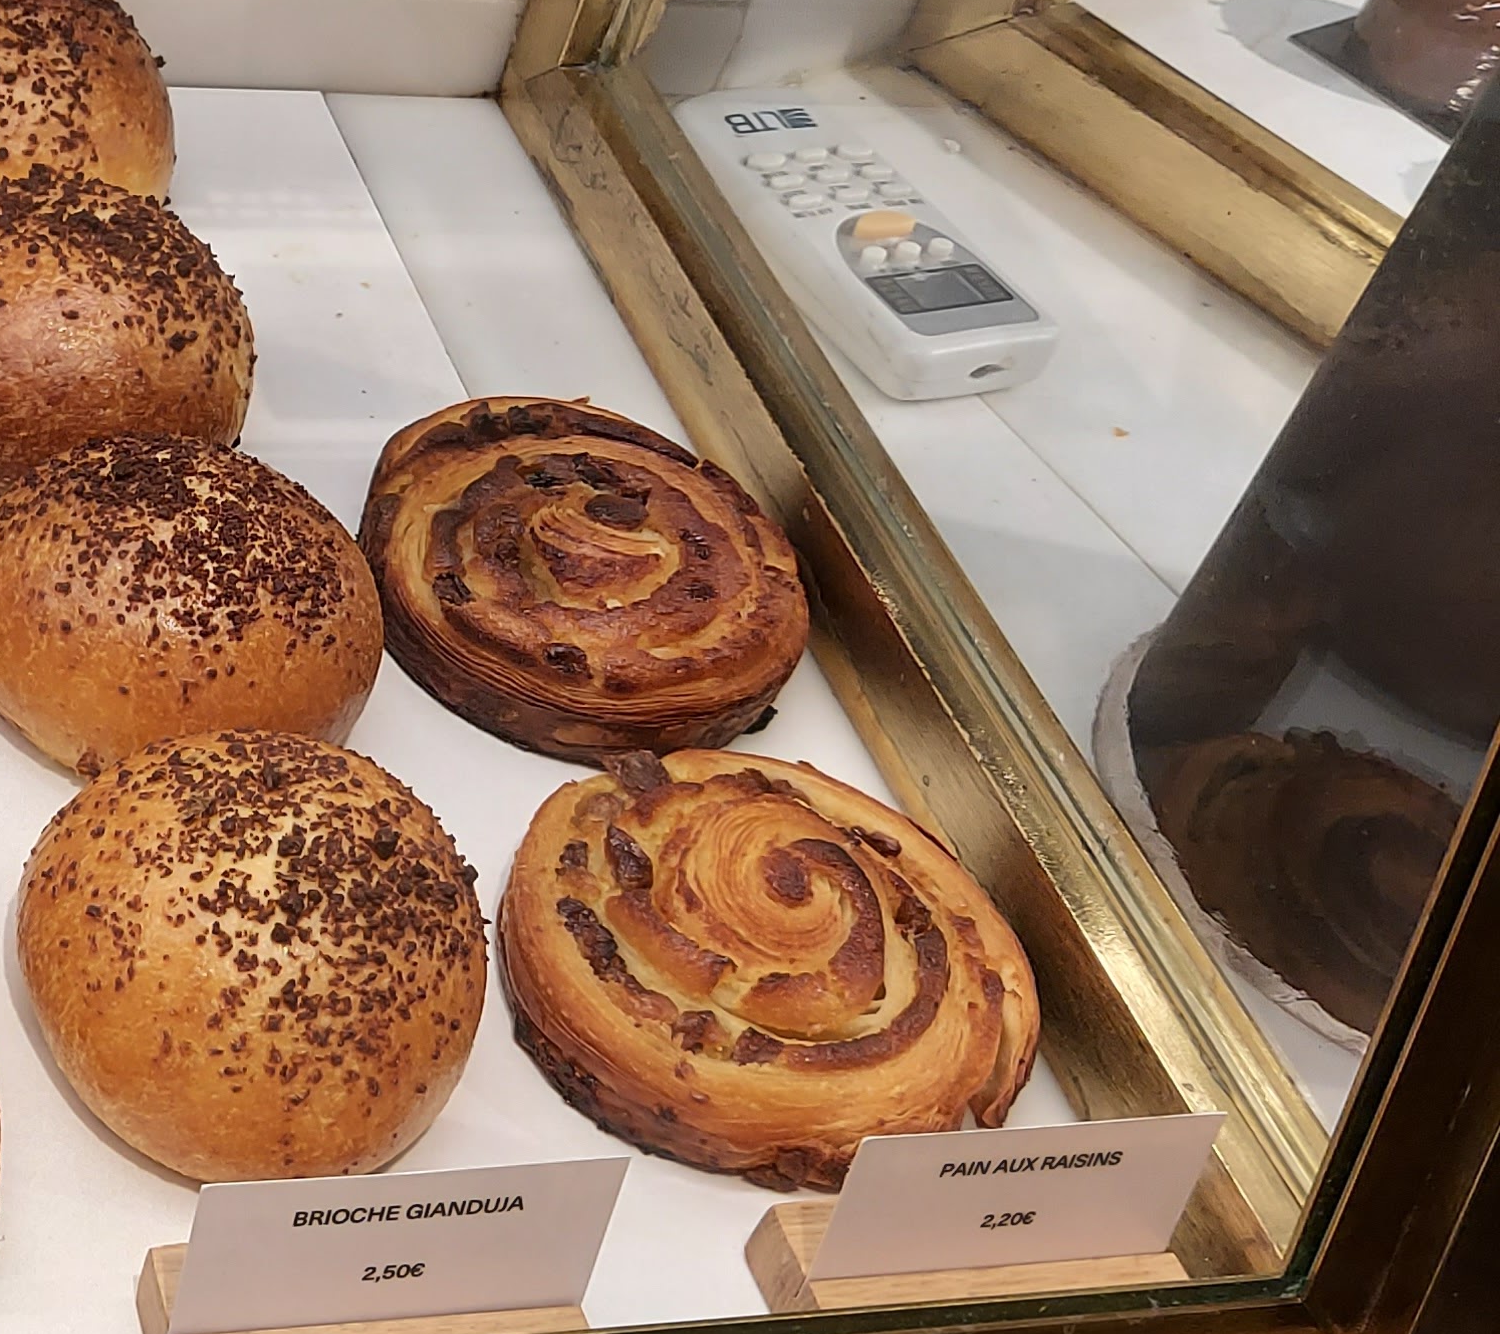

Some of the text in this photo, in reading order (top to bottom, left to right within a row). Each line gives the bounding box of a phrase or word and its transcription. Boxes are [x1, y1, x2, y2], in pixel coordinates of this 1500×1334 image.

[939, 1151, 1123, 1178] PAIN AUX RAISINS
[292, 1195, 525, 1228] BRIOCHE GIANDUJA
[980, 1210, 1037, 1230] 2,20€
[361, 1262, 426, 1284] 2,50€
